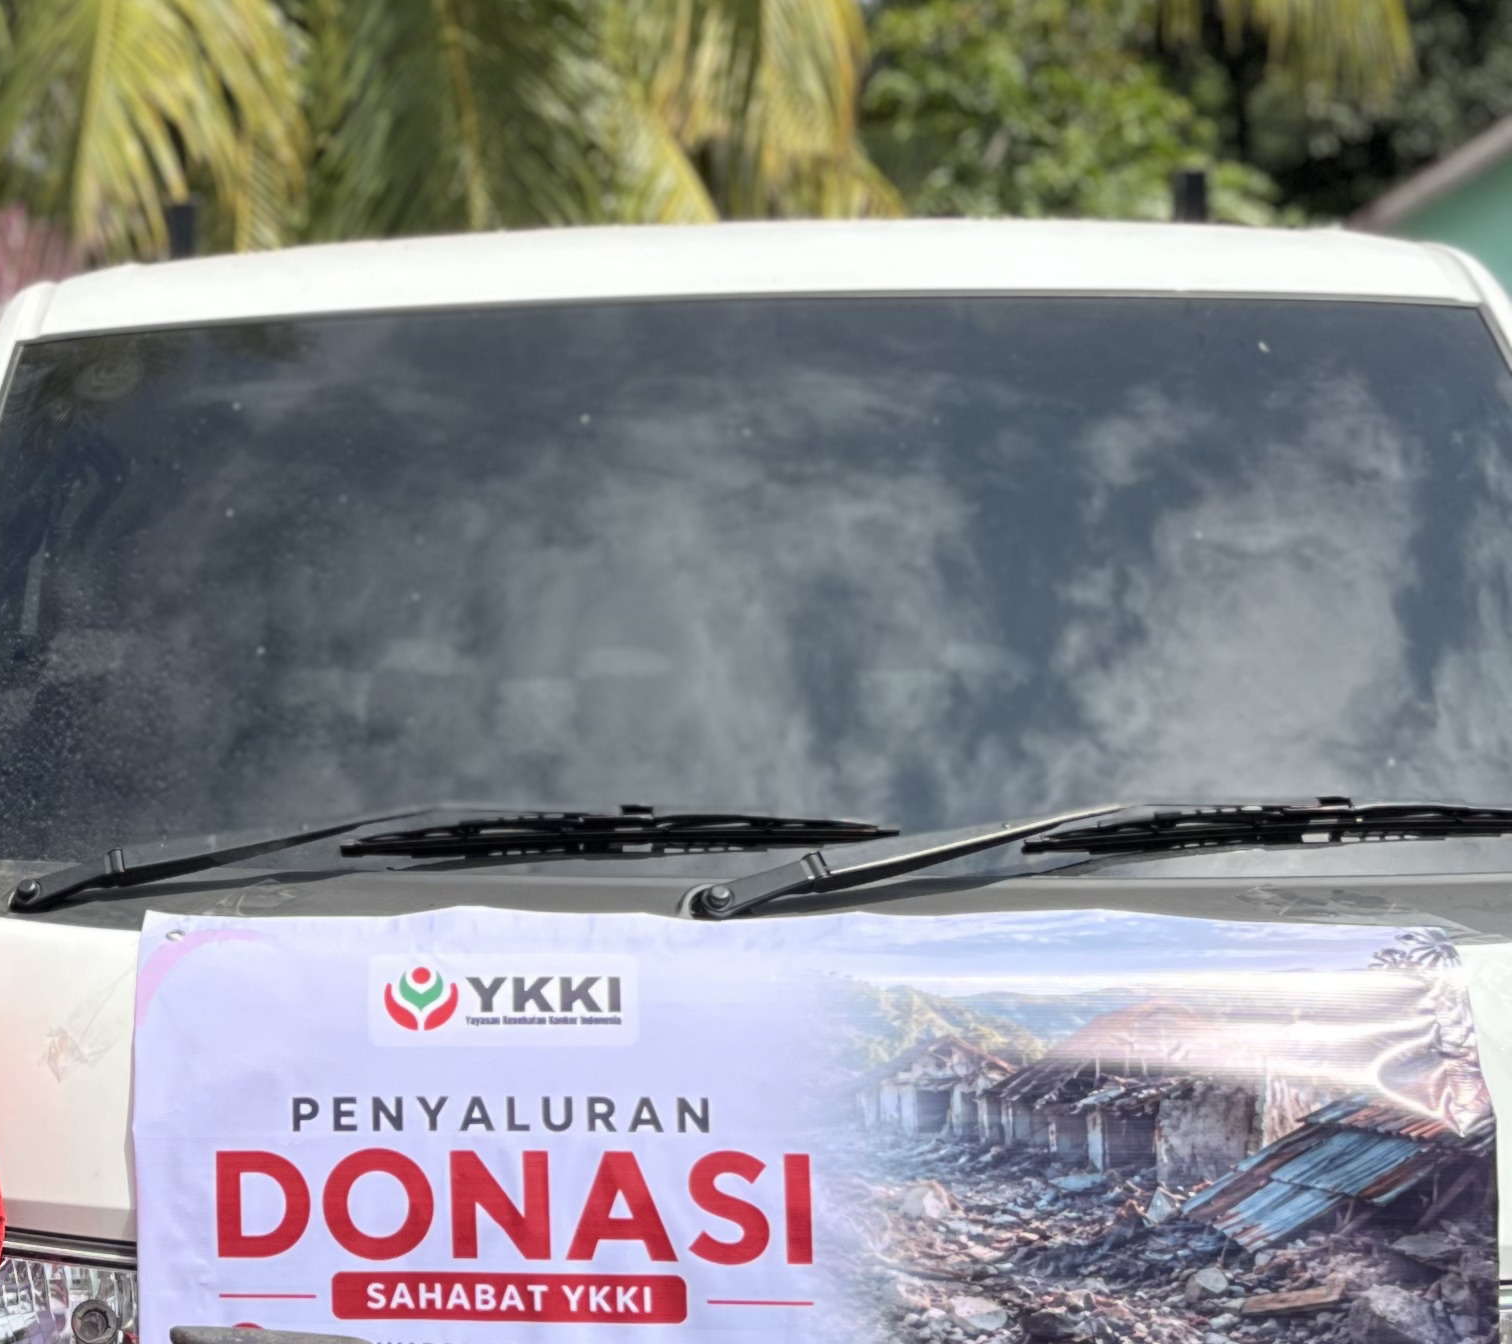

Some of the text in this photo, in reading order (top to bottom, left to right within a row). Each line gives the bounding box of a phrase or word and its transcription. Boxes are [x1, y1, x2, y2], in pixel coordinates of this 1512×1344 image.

[465, 976, 621, 1013] YKKI
[291, 1096, 711, 1133] PENYALURAN
[216, 1147, 814, 1266] DONASI
[366, 1282, 653, 1314] SAHABAT YKKI
